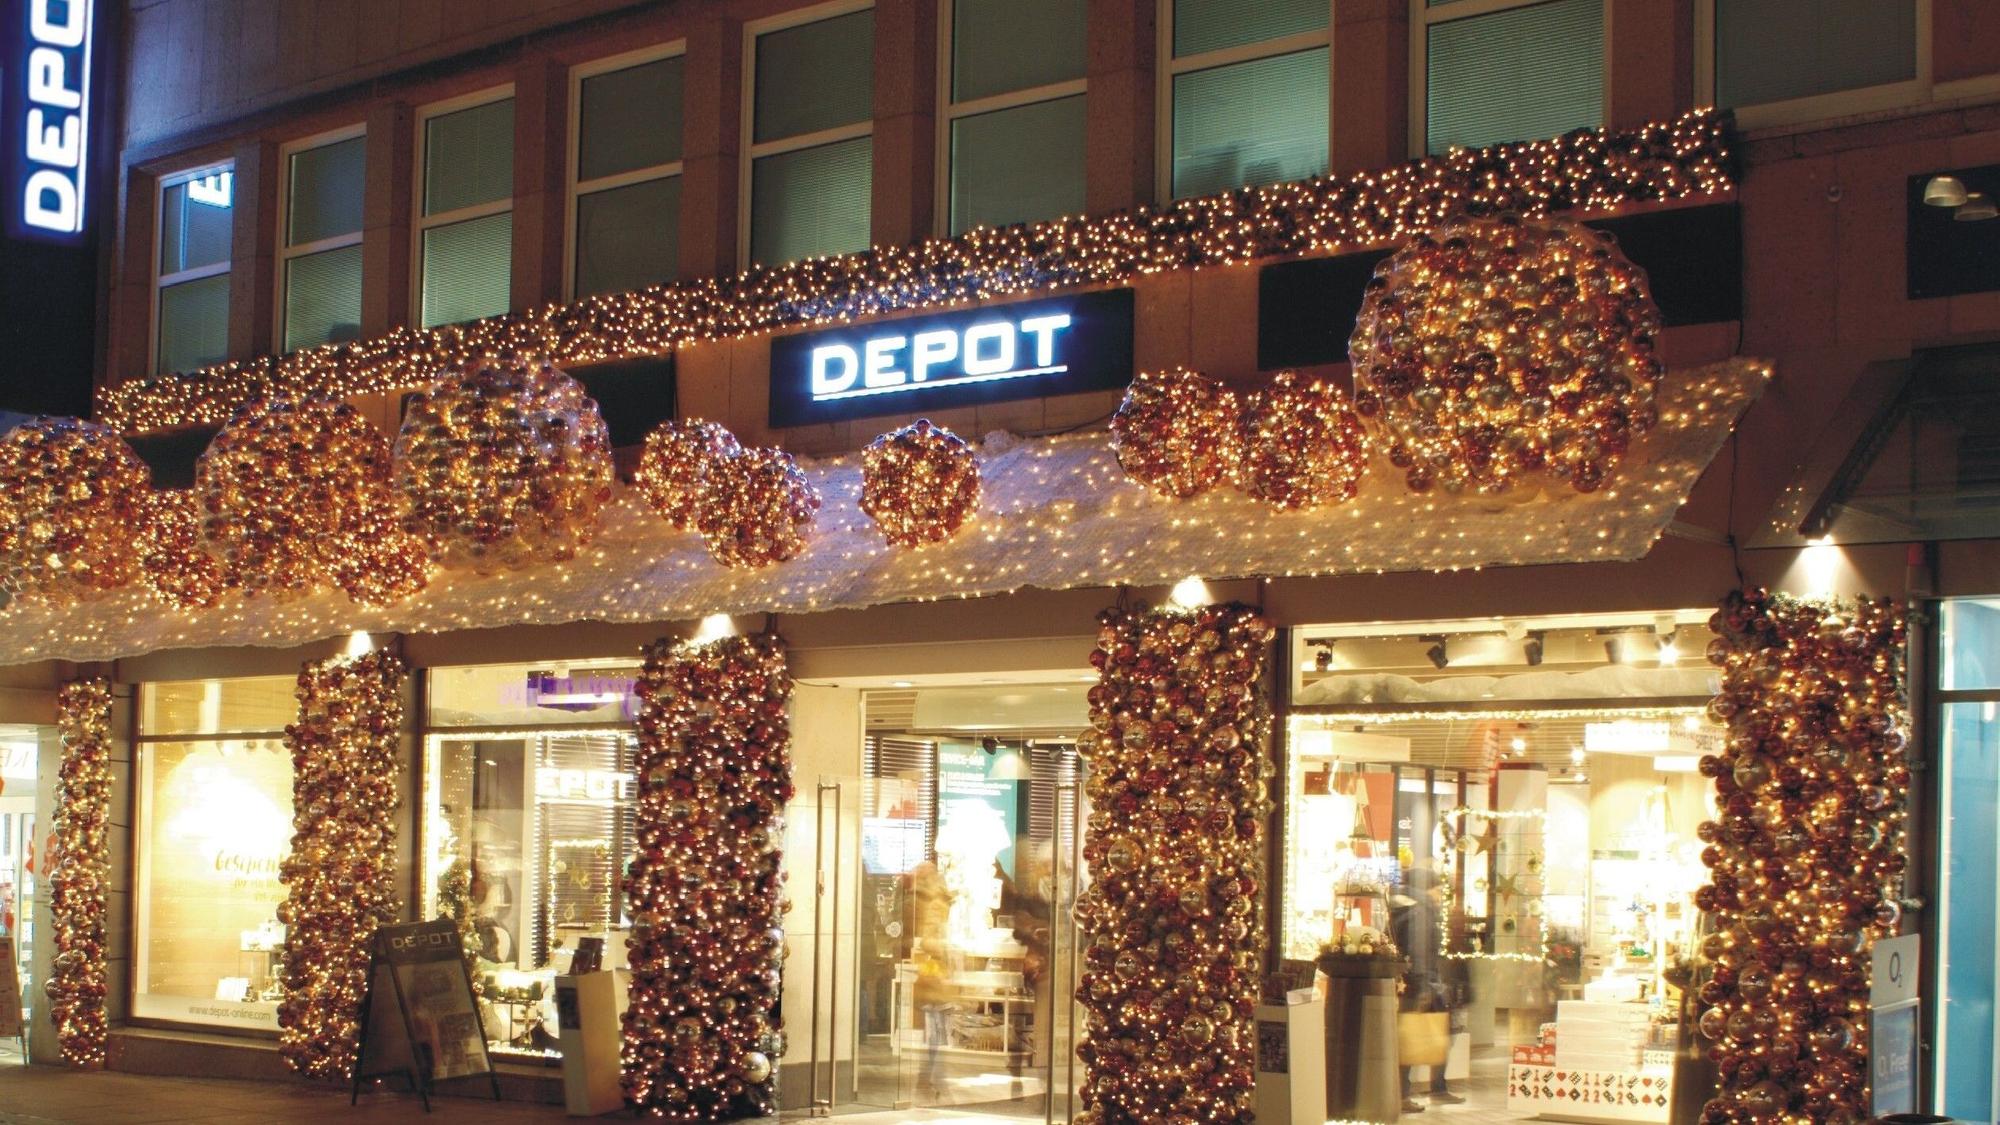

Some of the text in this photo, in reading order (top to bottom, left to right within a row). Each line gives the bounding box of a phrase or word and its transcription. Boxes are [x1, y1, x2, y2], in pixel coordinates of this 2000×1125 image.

[812, 314, 1071, 396] DEPOT
[391, 931, 454, 949] DEPOT
[188, 1006, 271, 1021] www.depot-online.com
